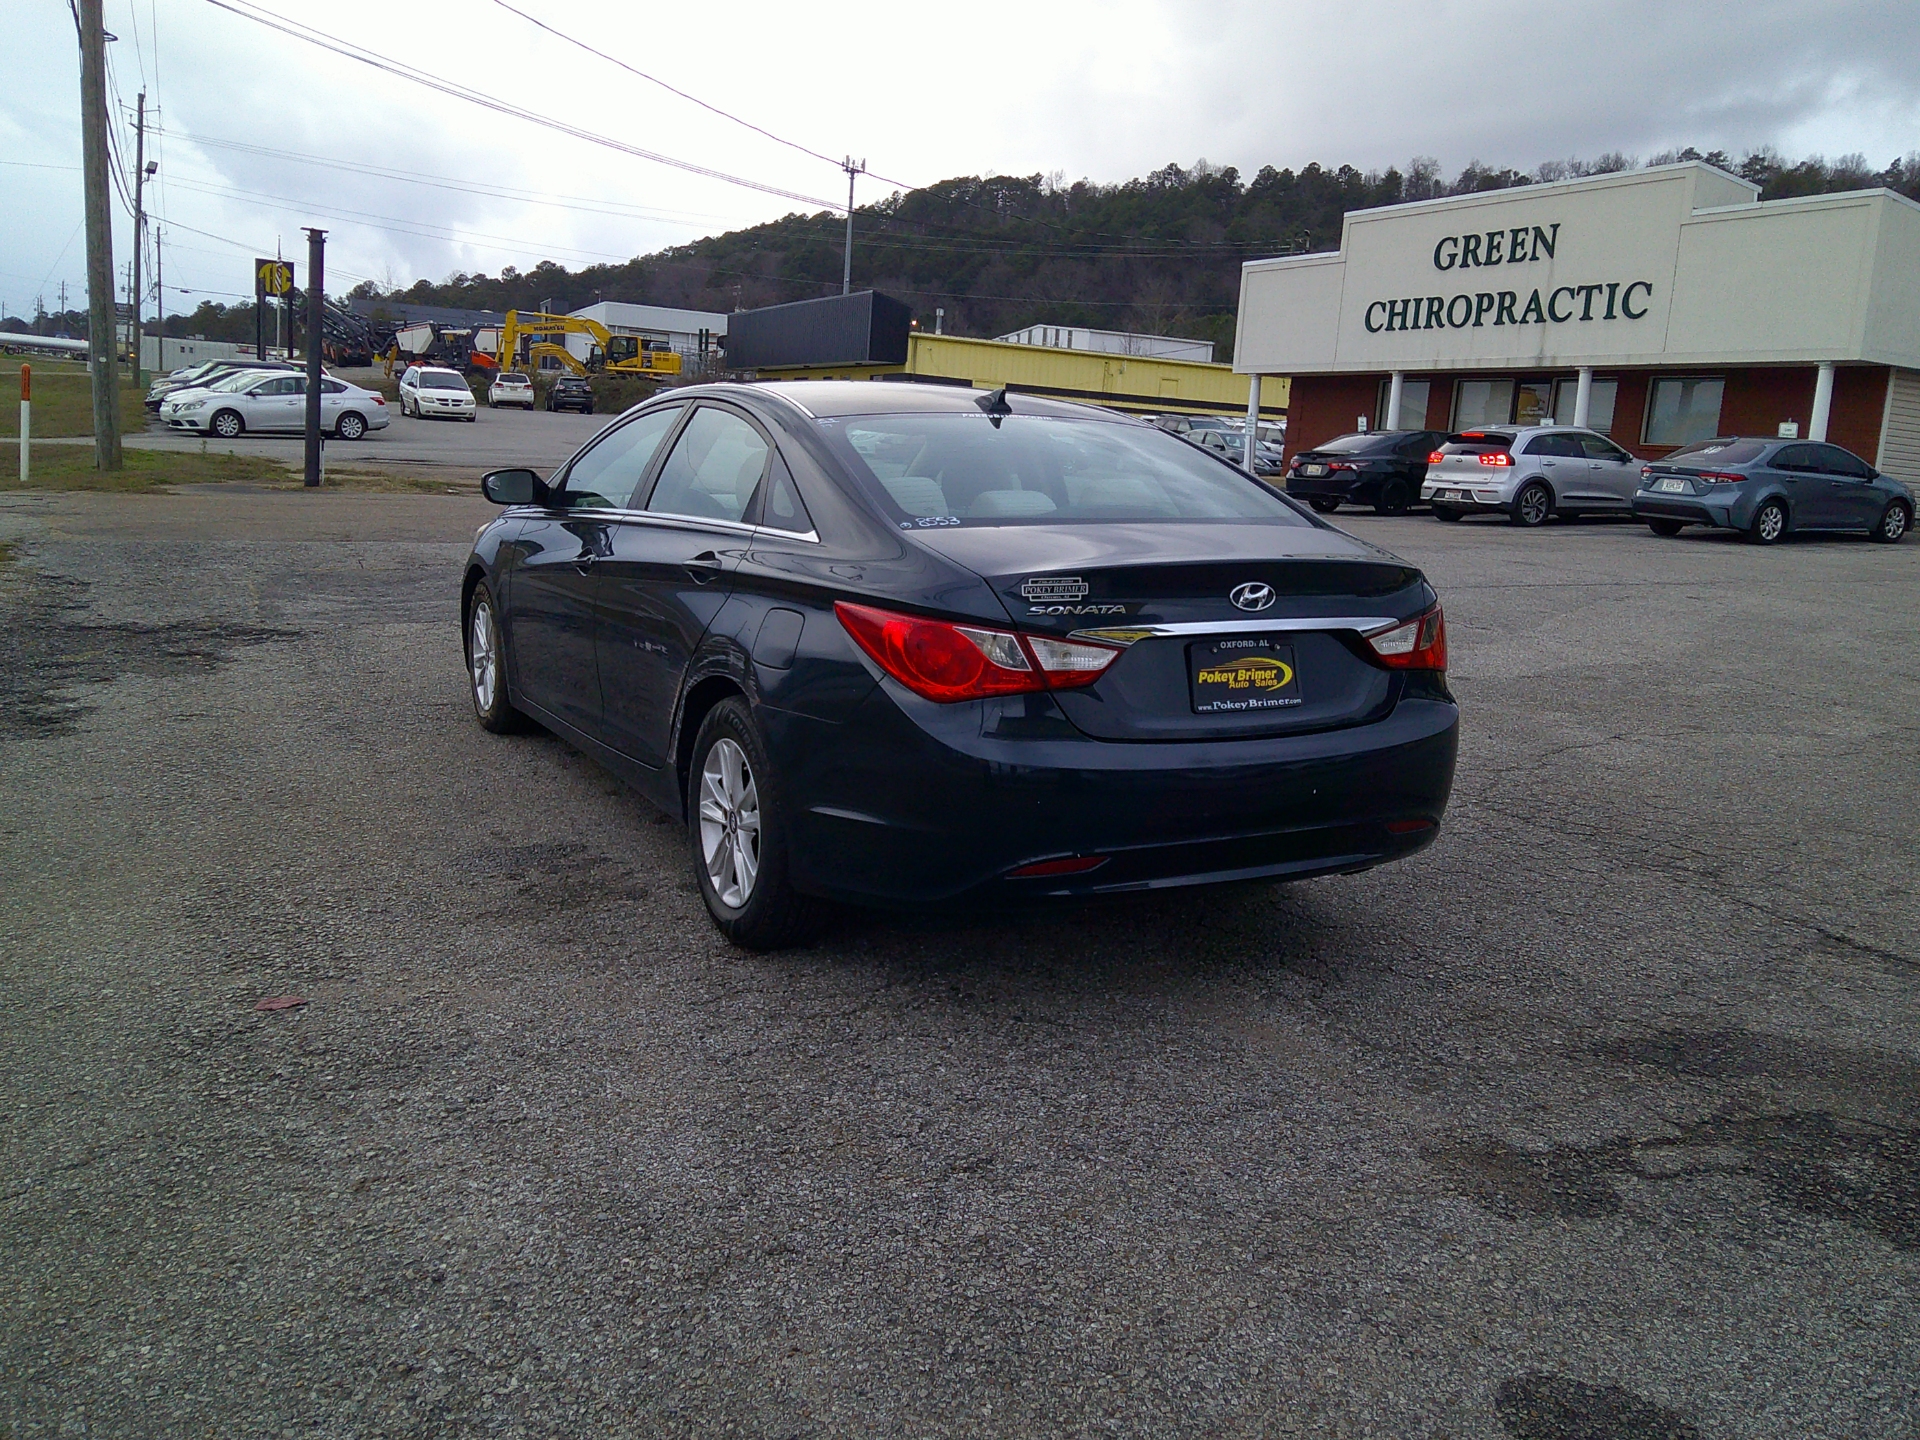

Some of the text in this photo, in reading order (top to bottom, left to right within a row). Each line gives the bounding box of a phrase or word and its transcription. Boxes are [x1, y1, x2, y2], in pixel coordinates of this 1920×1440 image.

[1433, 223, 1561, 271] GREEN
[1365, 281, 1653, 333] CHIROPRACTIC
[915, 516, 961, 527] 8553
[1025, 585, 1086, 594] POKEY BRIMER
[1026, 604, 1127, 616] SONATA
[1259, 639, 1270, 648] AL
[1198, 668, 1278, 684] Pokey Brimer
[1228, 678, 1278, 690] Auto Sales
